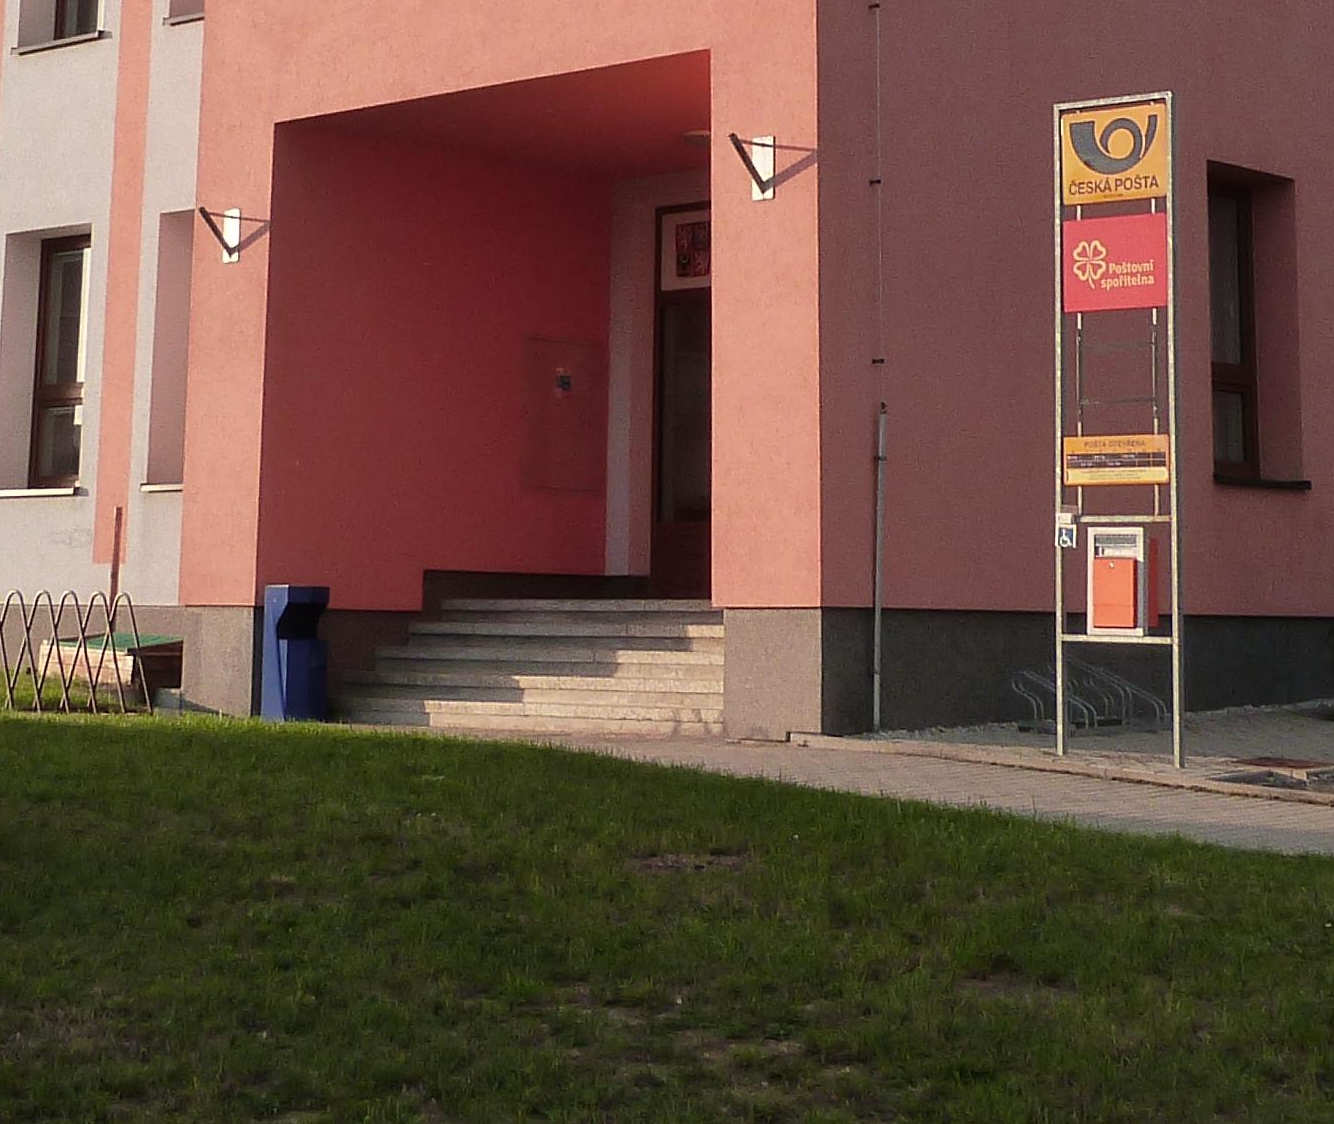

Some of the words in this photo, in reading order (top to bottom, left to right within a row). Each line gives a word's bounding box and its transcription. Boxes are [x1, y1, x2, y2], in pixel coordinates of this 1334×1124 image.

[1069, 178, 1112, 196] ČESKÁ
[1115, 175, 1159, 191] POŠTA
[1109, 259, 1154, 275] Poštovní
[1101, 274, 1155, 292] spořitelna
